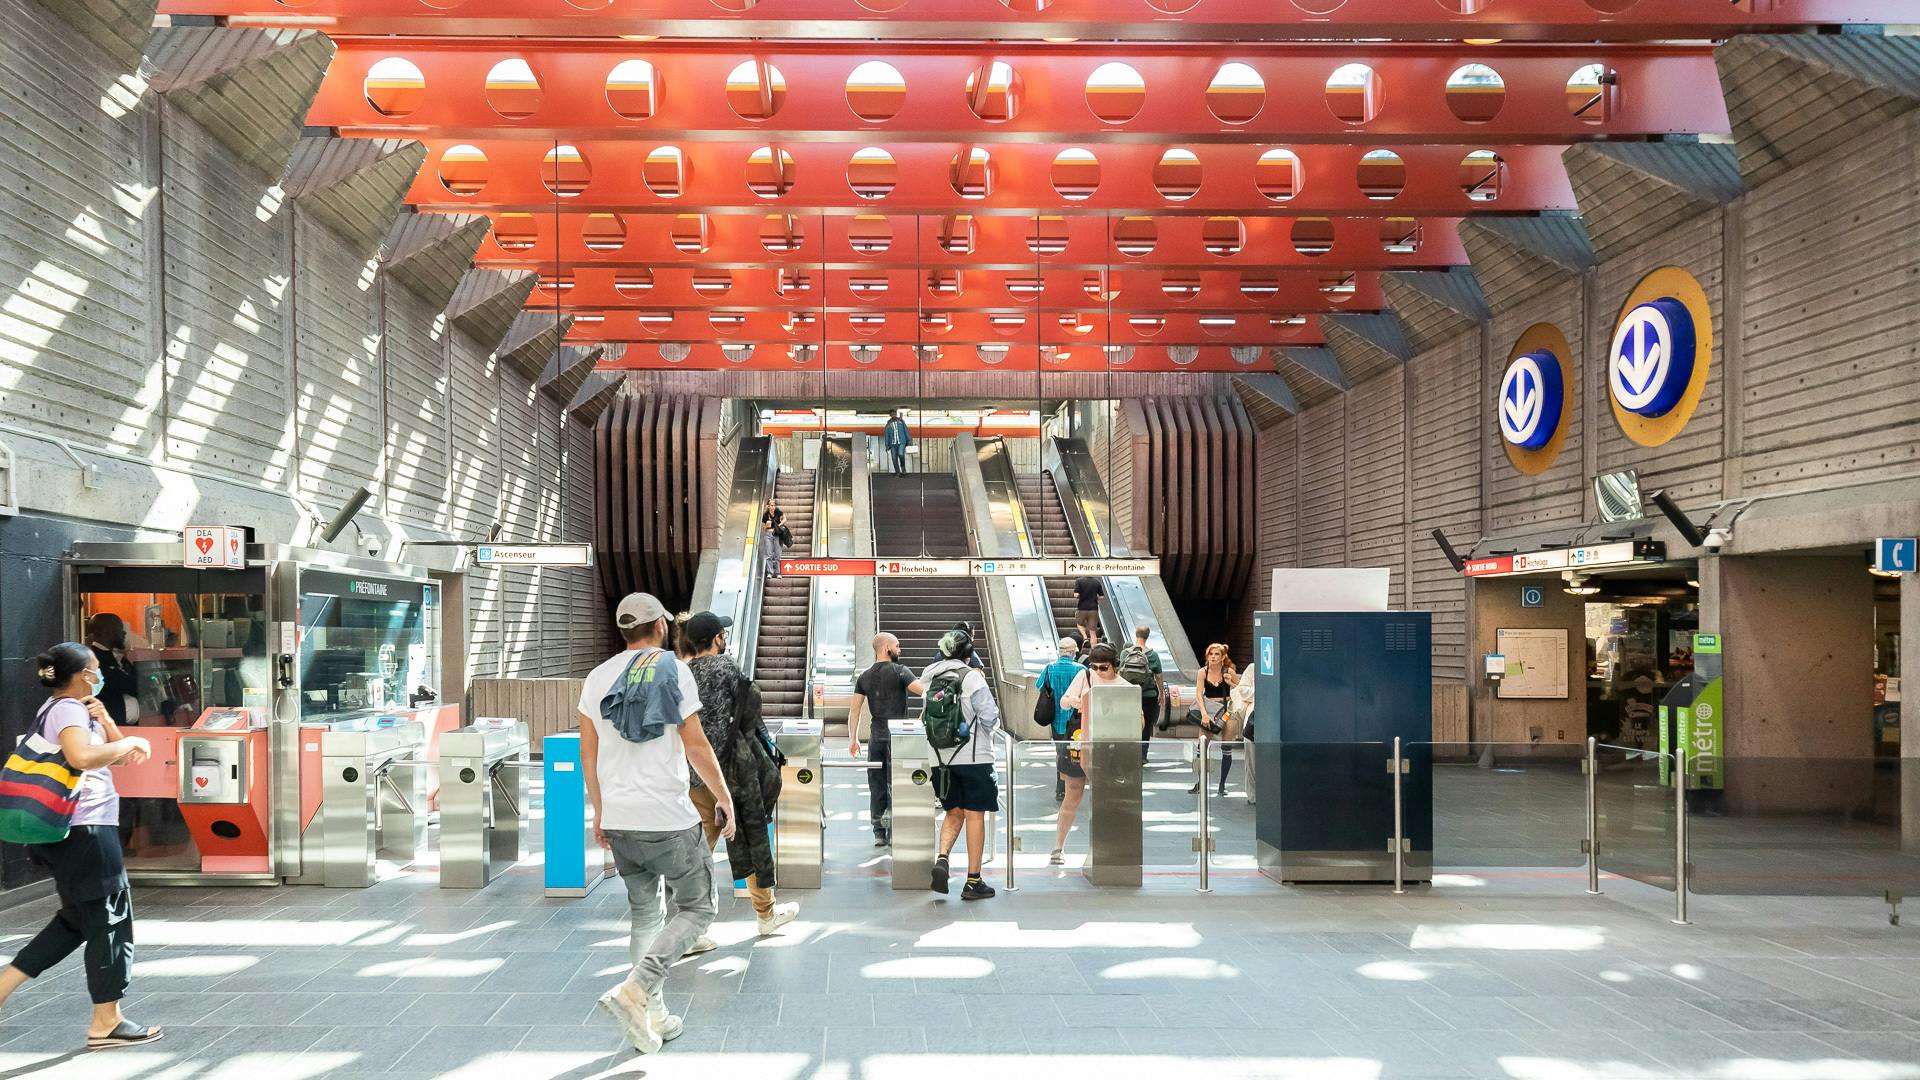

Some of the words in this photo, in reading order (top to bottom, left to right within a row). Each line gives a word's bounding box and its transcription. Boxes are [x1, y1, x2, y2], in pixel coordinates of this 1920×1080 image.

[196, 529, 213, 537] DEA
[494, 550, 536, 559] Ascenseur
[197, 556, 213, 564] AED
[794, 563, 822, 572] SORTIE
[822, 563, 839, 572] SUD
[901, 565, 938, 574] Hochelaga
[355, 580, 388, 596] PRÉFONTAINE
[1692, 703, 1713, 772] métro
